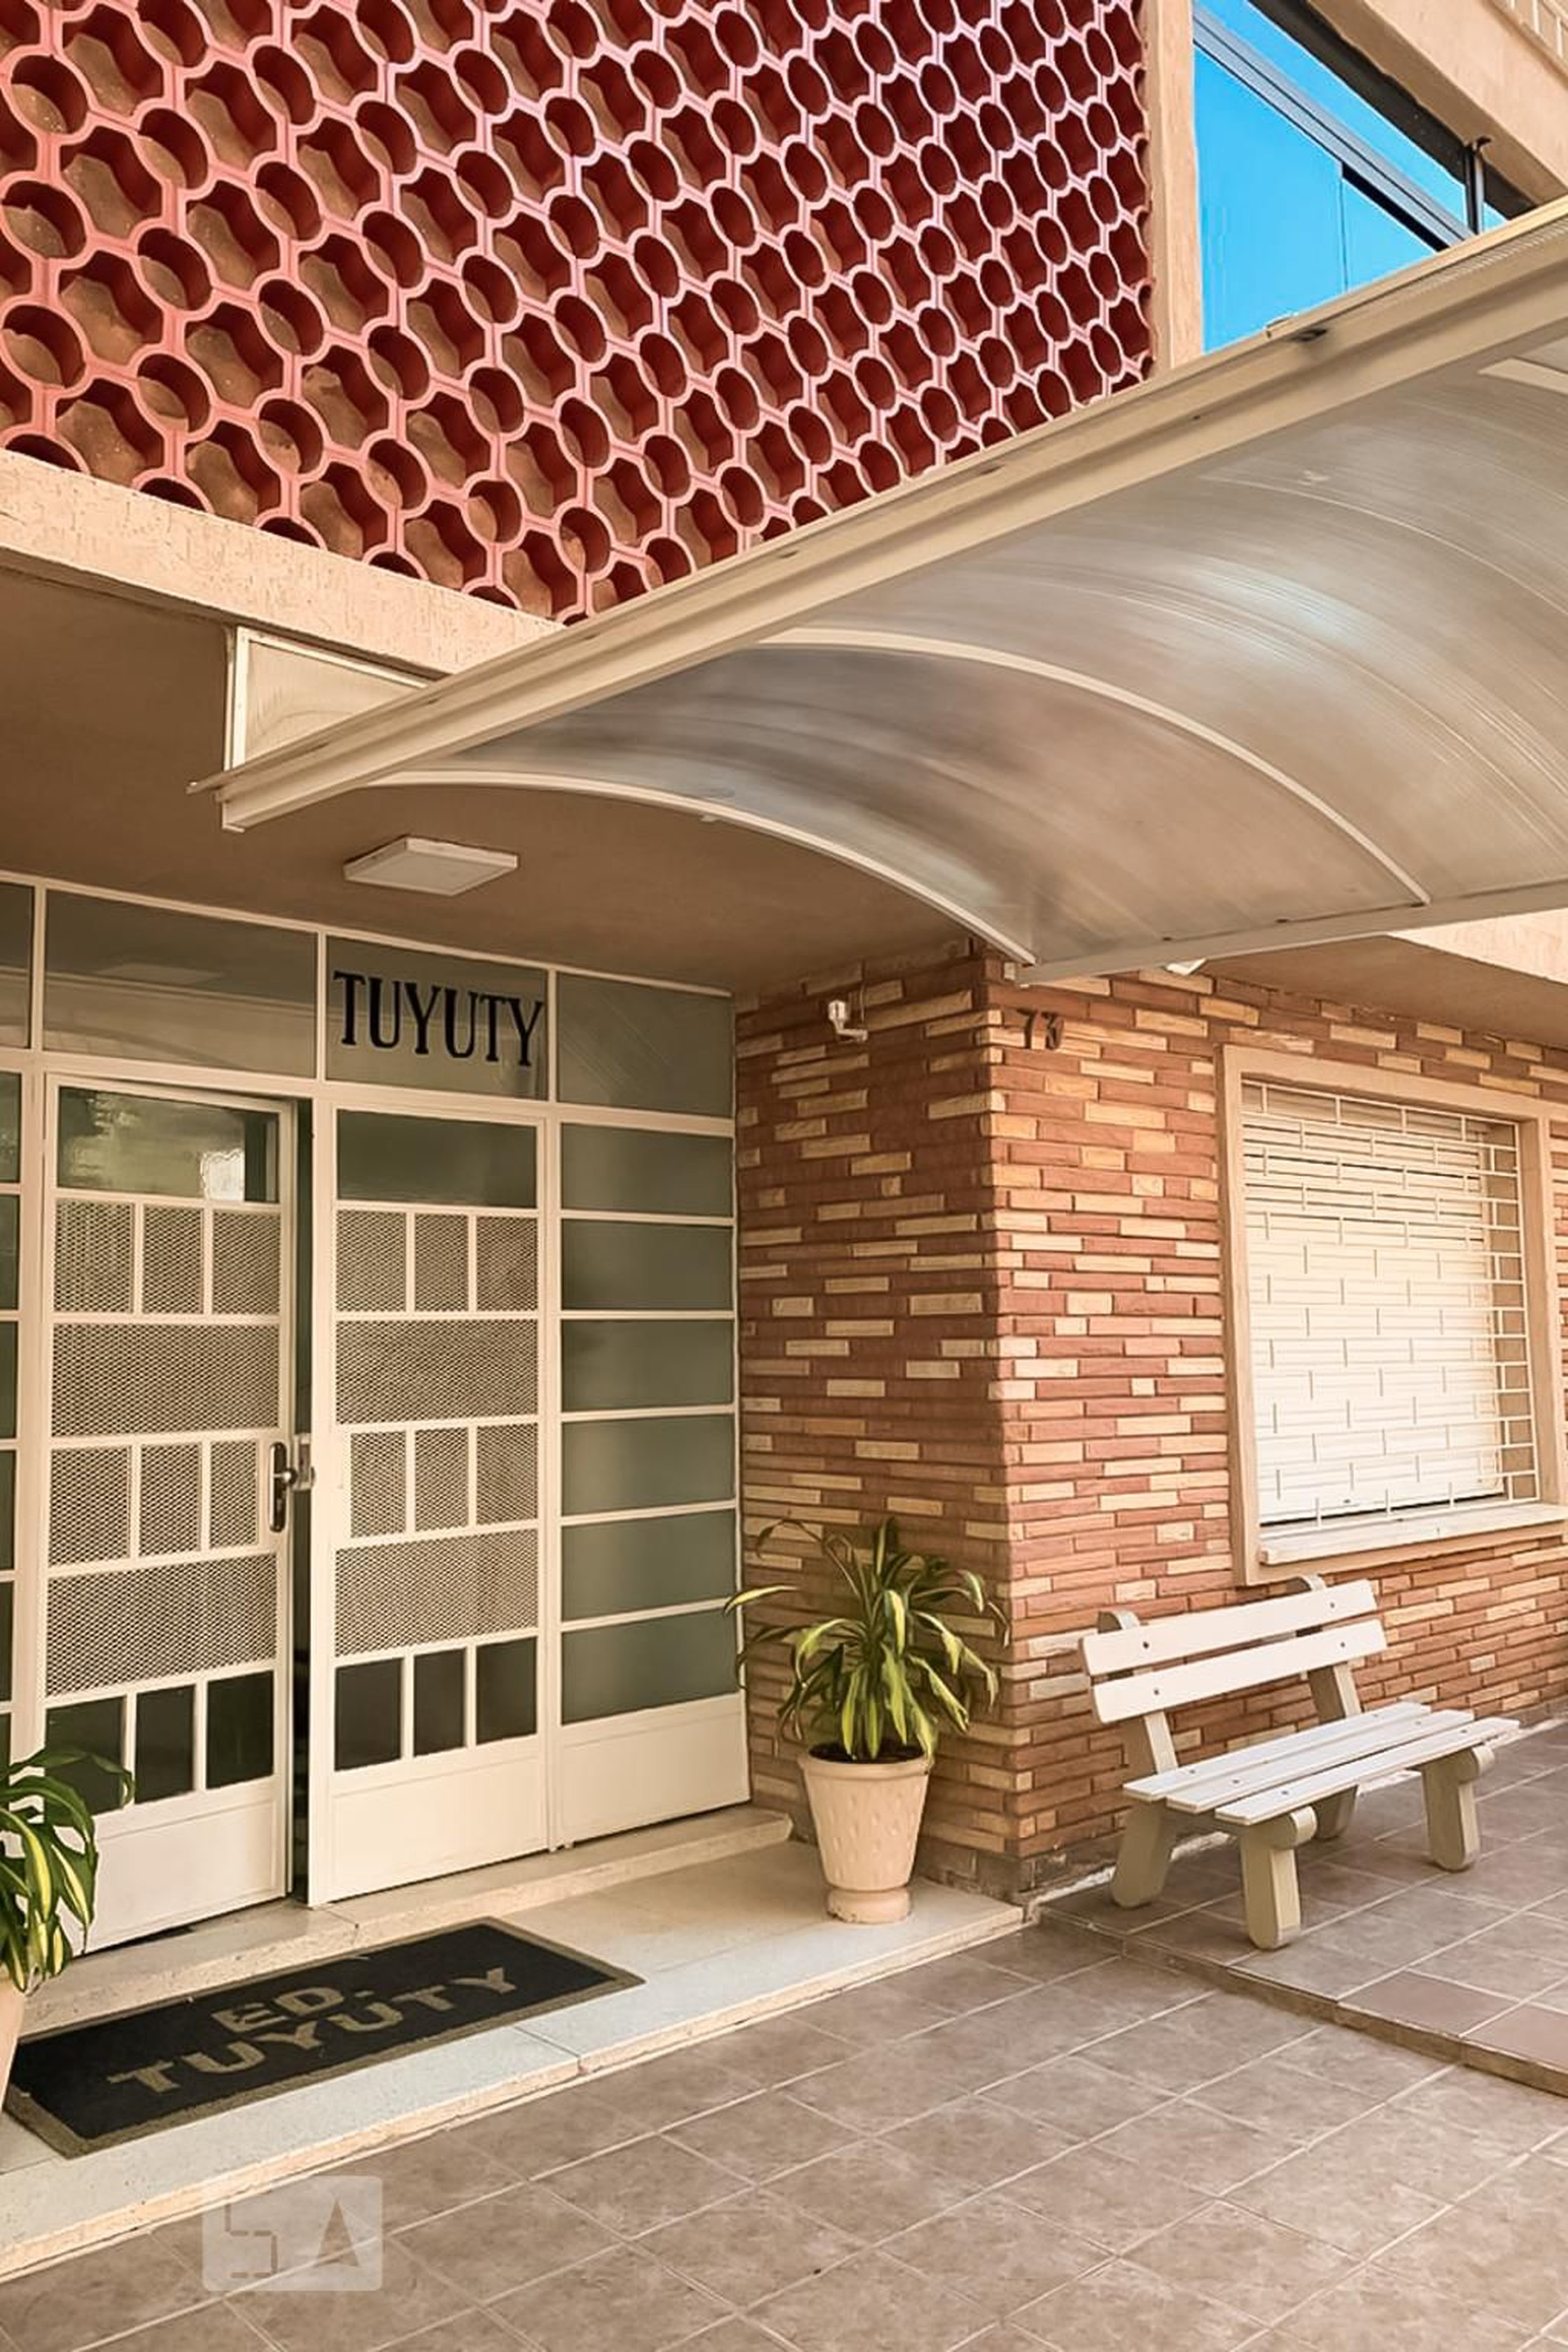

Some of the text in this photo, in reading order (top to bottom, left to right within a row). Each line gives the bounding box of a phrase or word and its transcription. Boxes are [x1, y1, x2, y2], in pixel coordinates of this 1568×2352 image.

[333, 970, 543, 1067] TUYUTY
[1016, 1007, 1064, 1050] 73
[107, 1967, 517, 2094] TUYUTY
[211, 1987, 374, 2033] ED.
